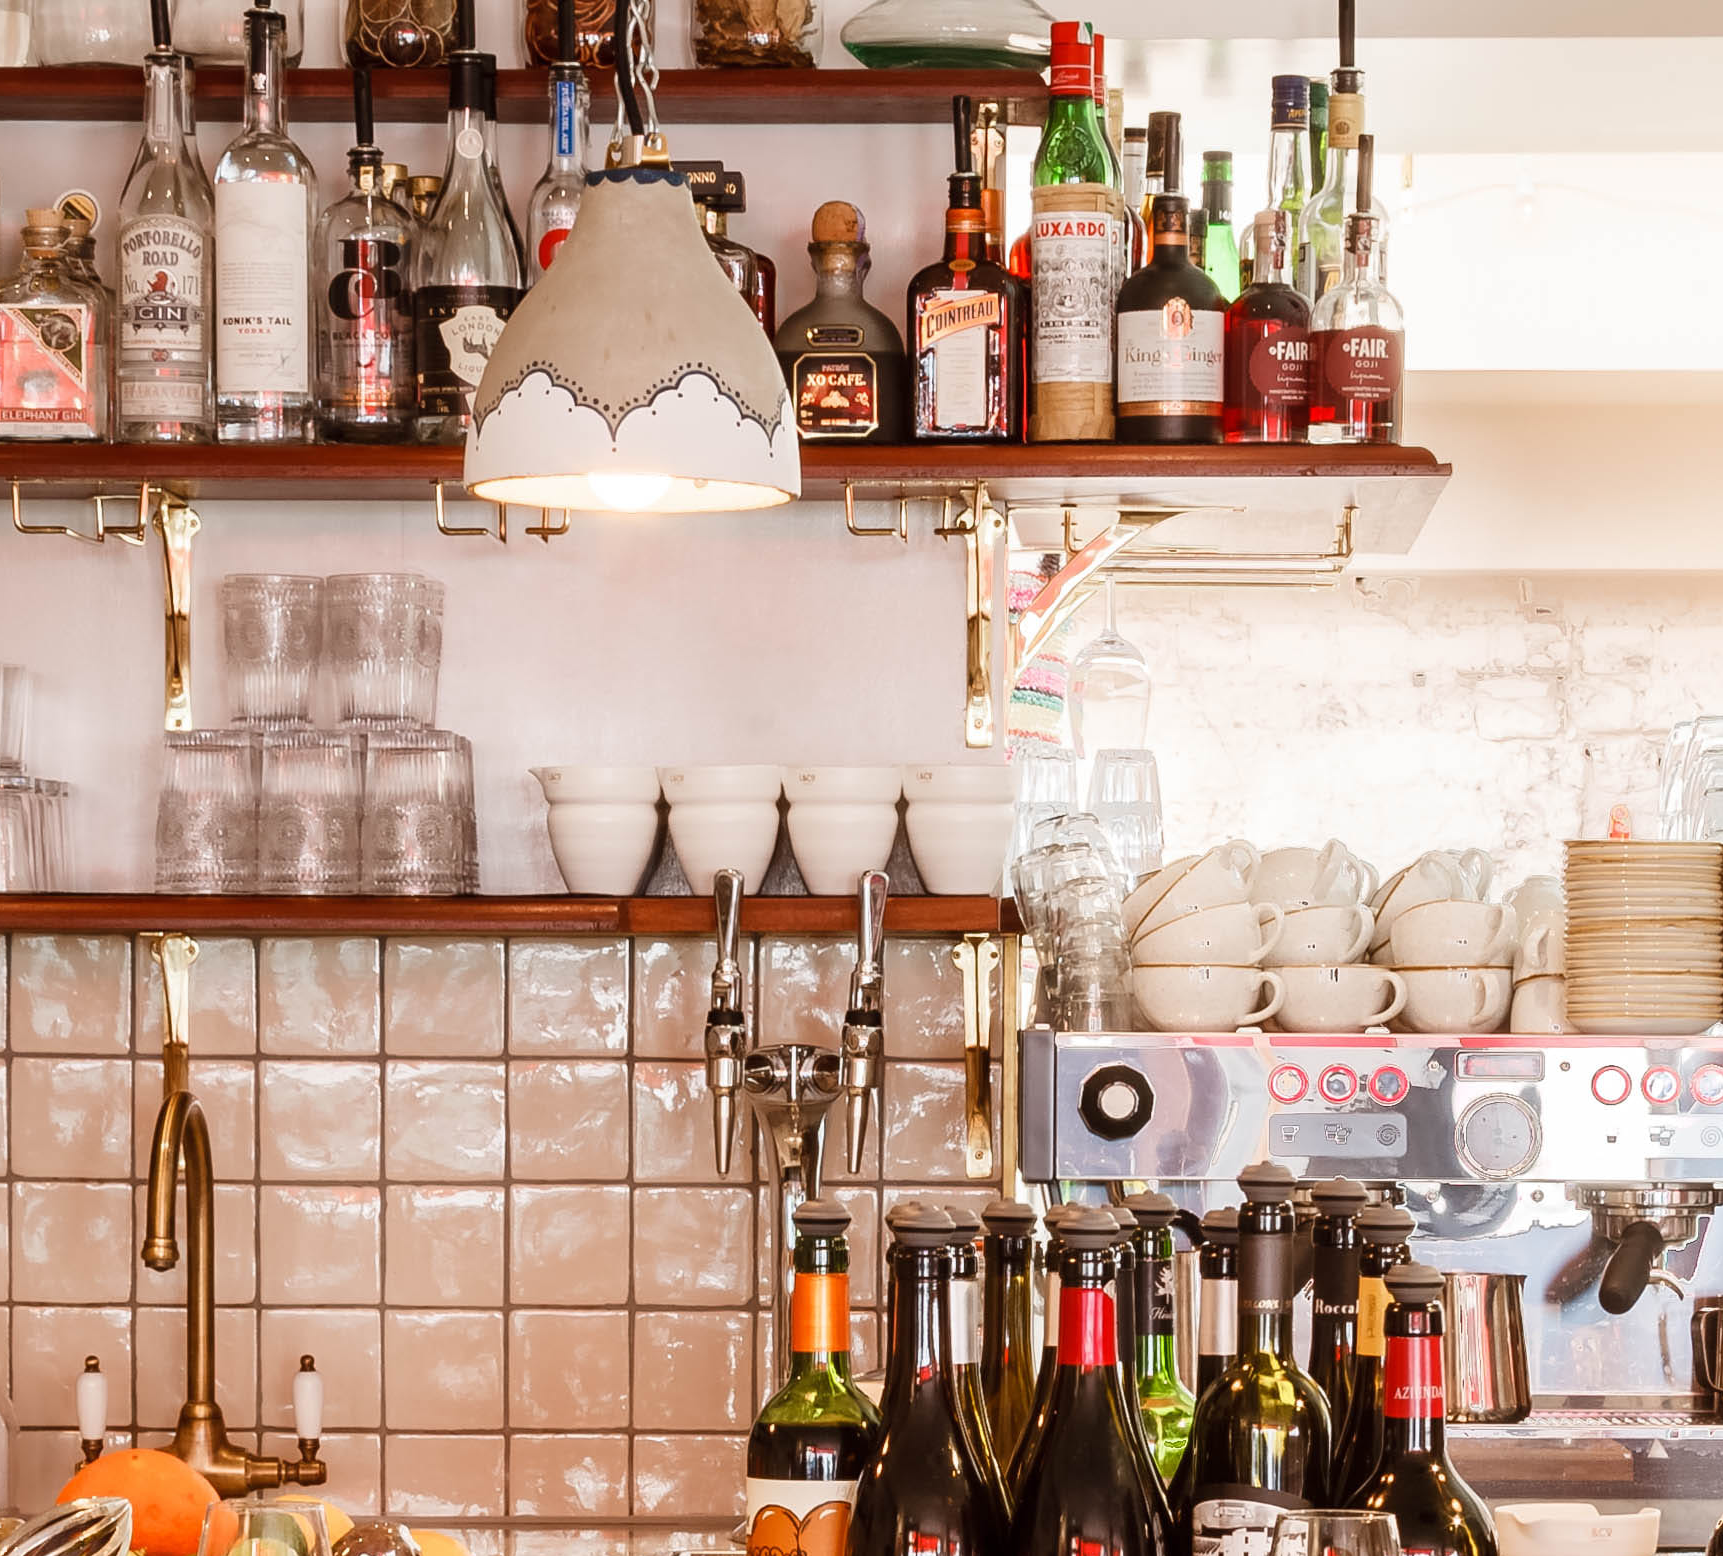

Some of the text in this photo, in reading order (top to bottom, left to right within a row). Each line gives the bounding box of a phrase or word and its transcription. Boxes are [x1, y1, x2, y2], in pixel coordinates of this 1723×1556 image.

[1035, 221, 1106, 238] LUXARDO
[123, 230, 202, 259] PORTOBELLO
[142, 251, 179, 266] ROAD
[138, 307, 183, 320] GIN
[926, 299, 994, 339] COINTREAU
[267, 316, 292, 326] TAIL
[238, 327, 272, 335] VODKA
[451, 322, 501, 337] LONDON
[1281, 363, 1304, 372] GOJI
[1355, 360, 1379, 369] GOJI
[806, 373, 827, 387] XO
[1, 410, 84, 422] ELEPHANT GIN
